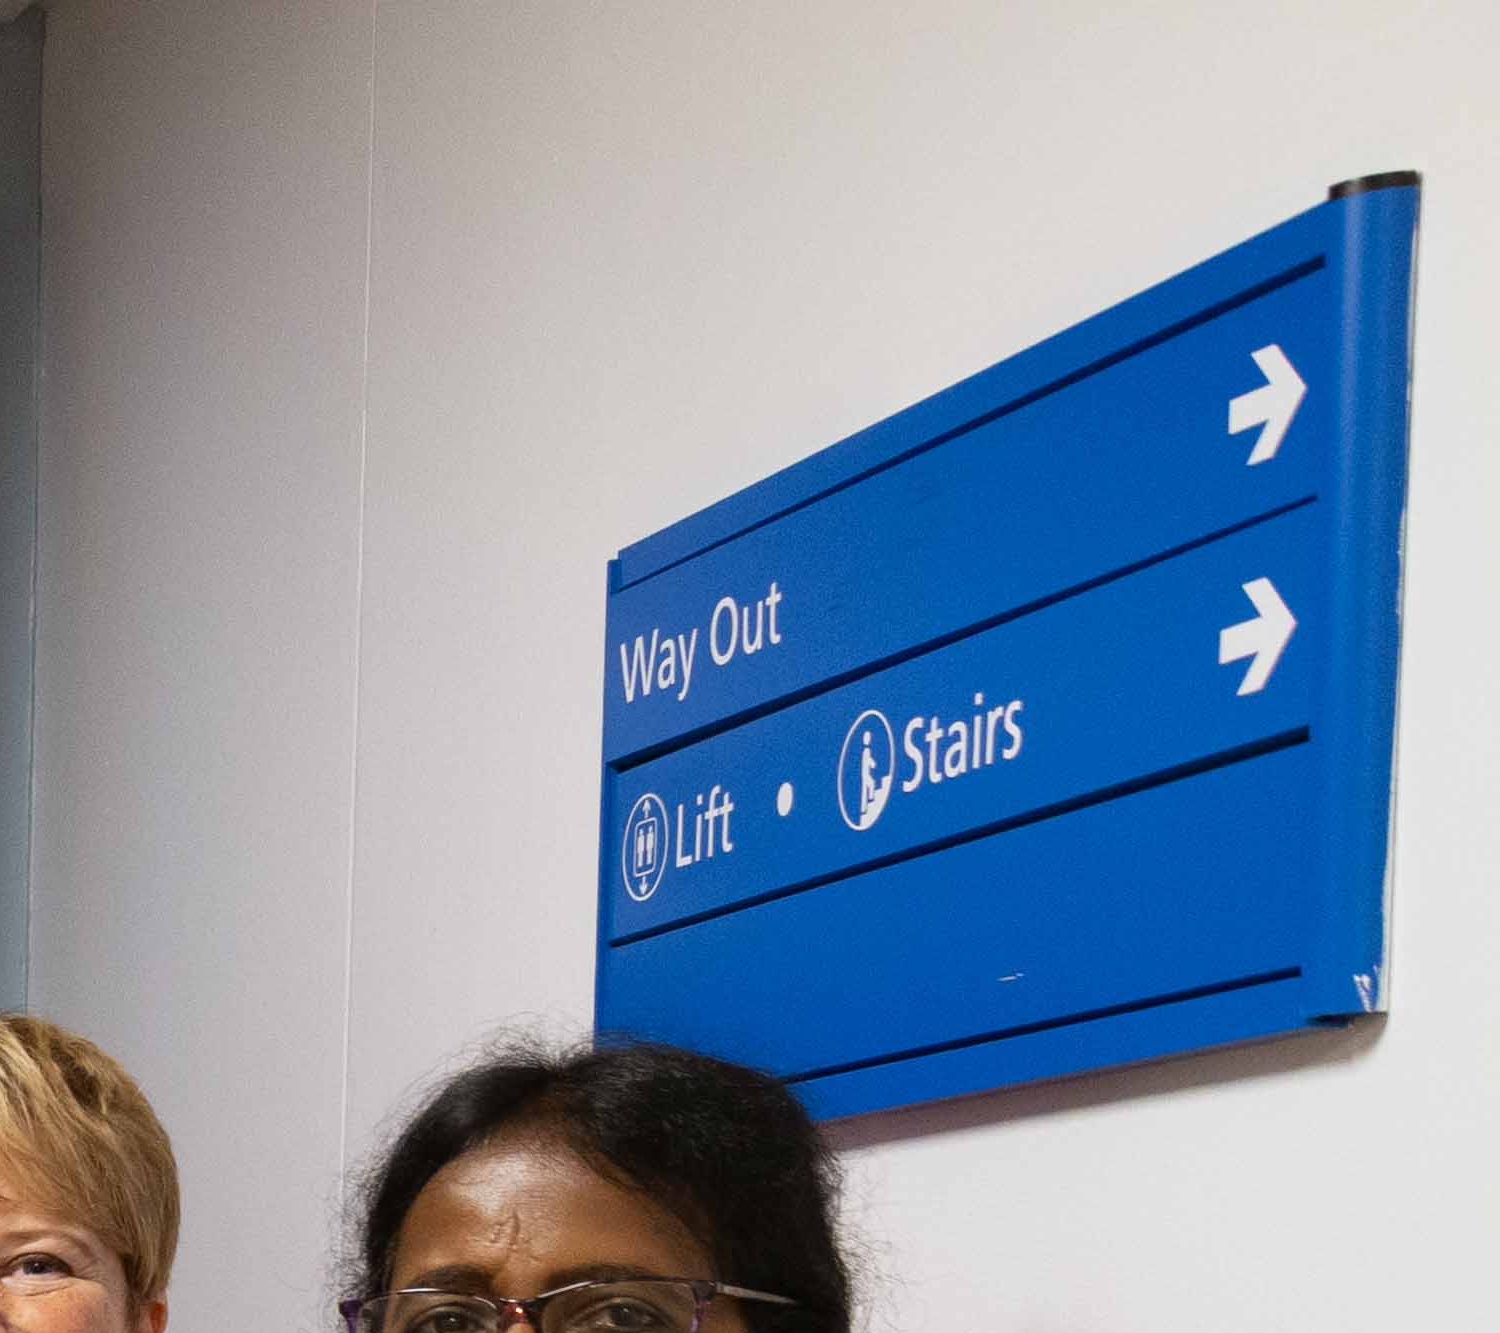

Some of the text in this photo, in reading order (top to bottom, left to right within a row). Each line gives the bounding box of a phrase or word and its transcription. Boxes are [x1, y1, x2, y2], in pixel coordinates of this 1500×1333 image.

[619, 581, 783, 704] Way Out
[675, 695, 1024, 868] Lift Stairs
